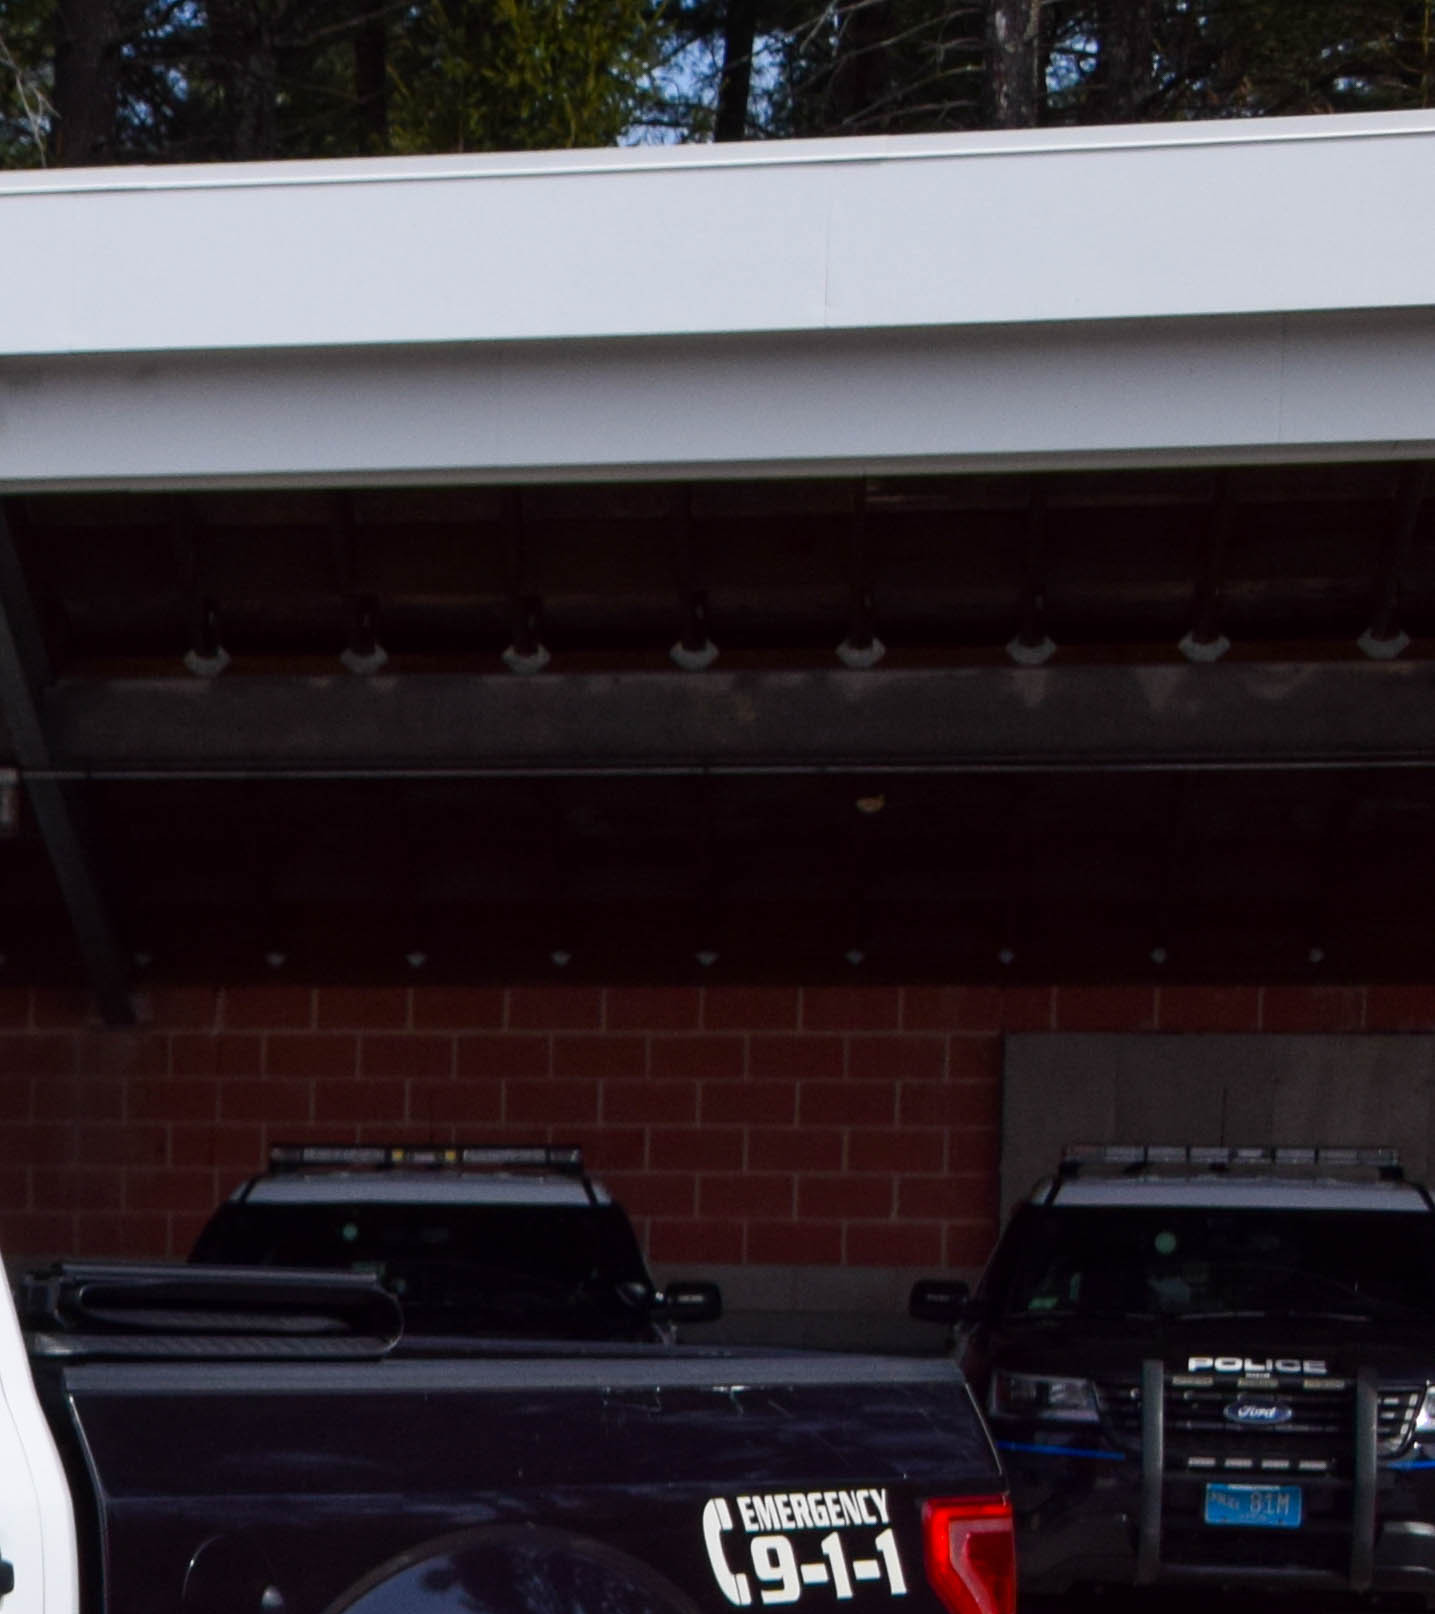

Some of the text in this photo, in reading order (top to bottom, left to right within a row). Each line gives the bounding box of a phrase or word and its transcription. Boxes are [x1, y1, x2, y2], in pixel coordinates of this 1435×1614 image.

[1188, 1357, 1328, 1374] POLICE
[1237, 1405, 1277, 1418] Ford
[736, 1488, 891, 1533] EMERGENCY
[749, 1527, 909, 1606] 9-1-1
